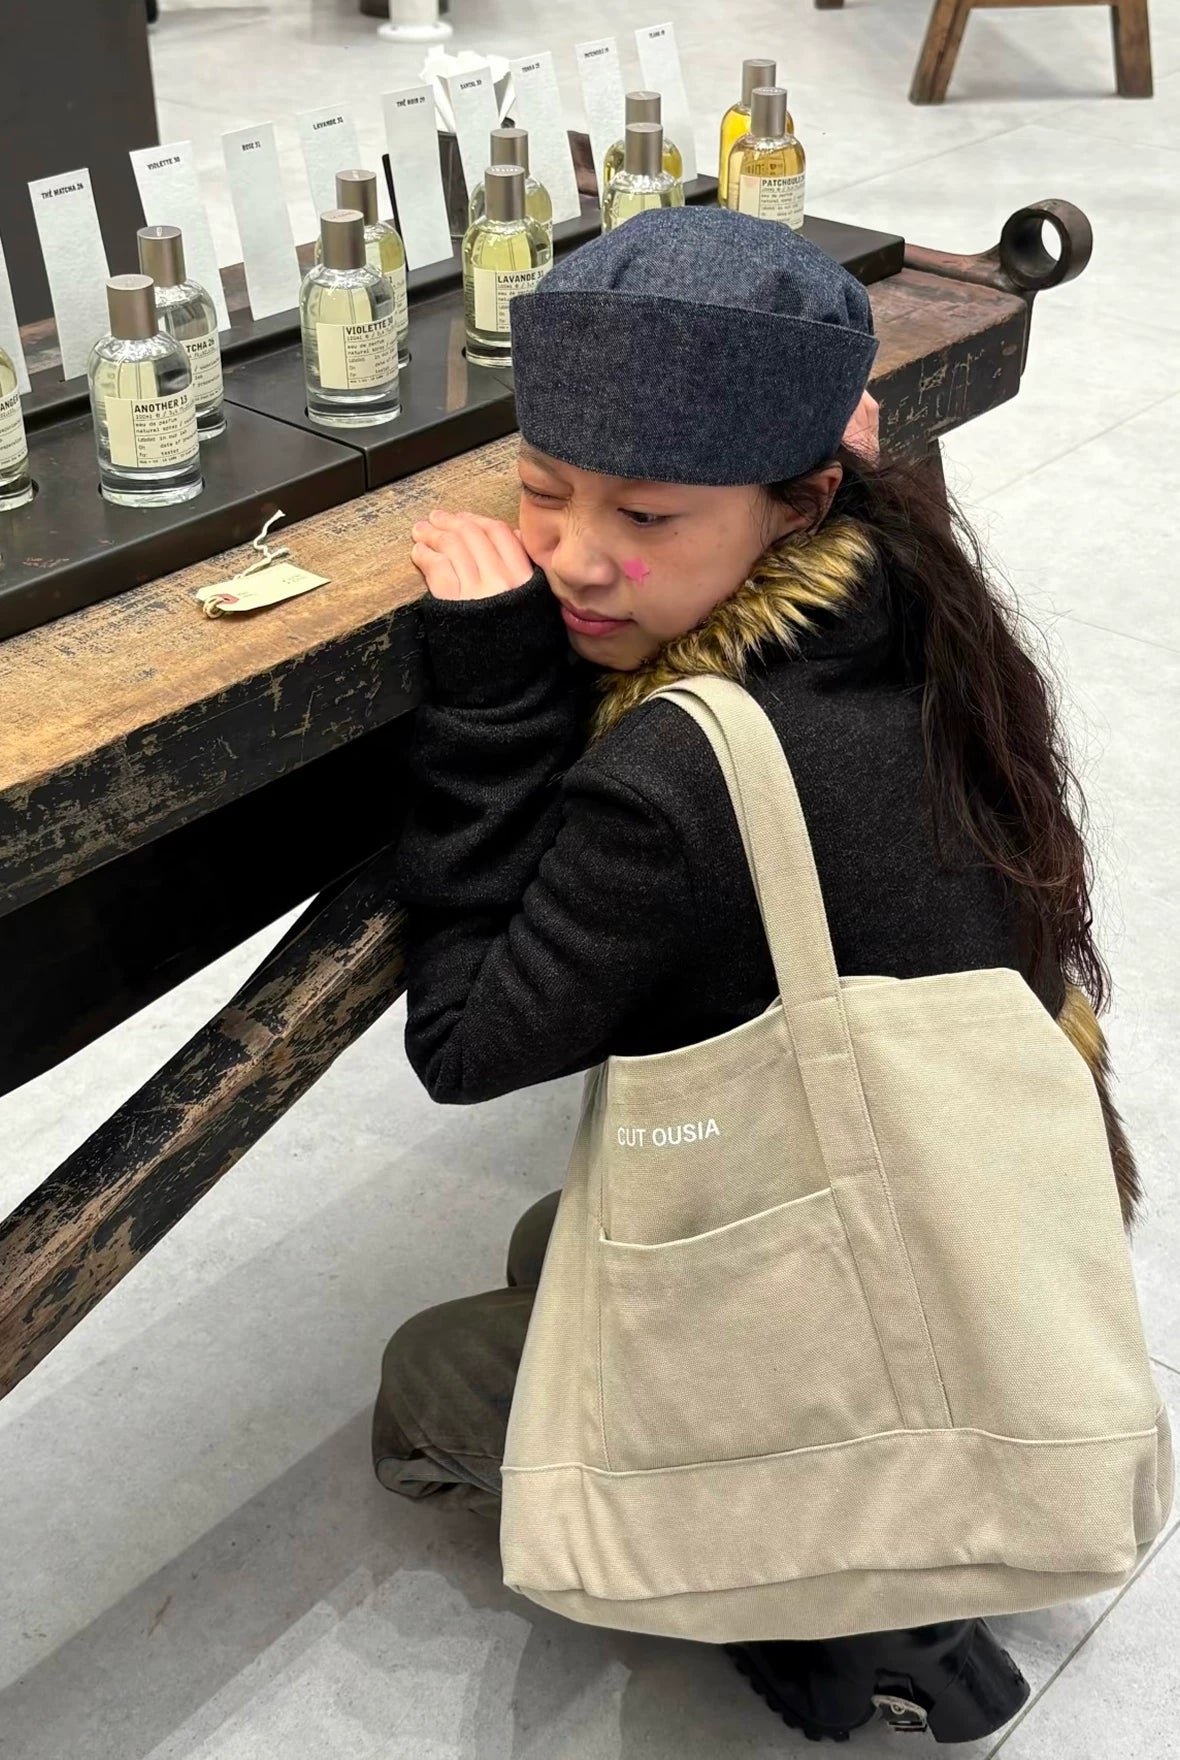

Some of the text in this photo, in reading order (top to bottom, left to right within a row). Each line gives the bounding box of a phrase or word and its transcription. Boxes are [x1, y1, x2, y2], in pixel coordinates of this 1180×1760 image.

[312, 118, 337, 130] LAVANDE
[241, 142, 254, 152] ROSE
[147, 158, 173, 170] VIOLETTE
[41, 182, 84, 200] THÉ MATCHA 26
[497, 272, 536, 284] LAVANDE
[346, 320, 387, 335] VIOLETTE
[186, 341, 207, 353] TCHA
[134, 400, 179, 413] ANOTHER
[180, 395, 188, 405] 13
[617, 1118, 720, 1147] CUT OUSIA
